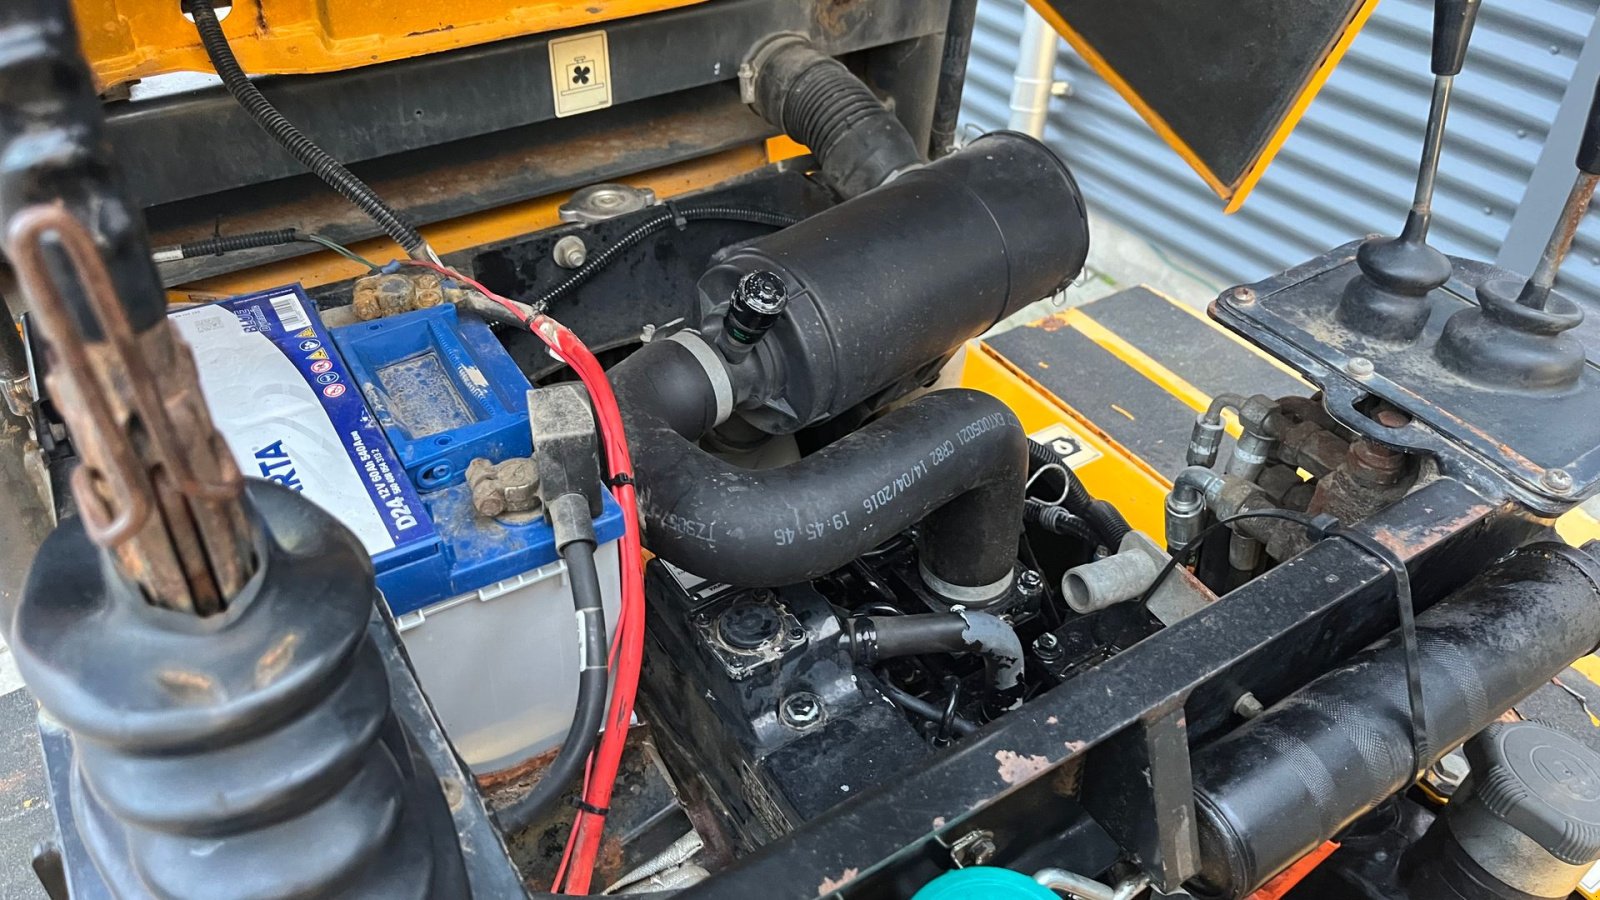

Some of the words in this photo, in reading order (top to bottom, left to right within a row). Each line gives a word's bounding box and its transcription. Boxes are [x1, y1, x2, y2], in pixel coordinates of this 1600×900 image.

[233, 308, 258, 333] BLUE
[254, 439, 304, 492] RTA
[929, 440, 955, 466] CR82
[364, 460, 382, 482] 60Ah
[374, 483, 391, 499] 12V
[862, 459, 929, 515] 14/04/2016
[385, 495, 418, 531] D24
